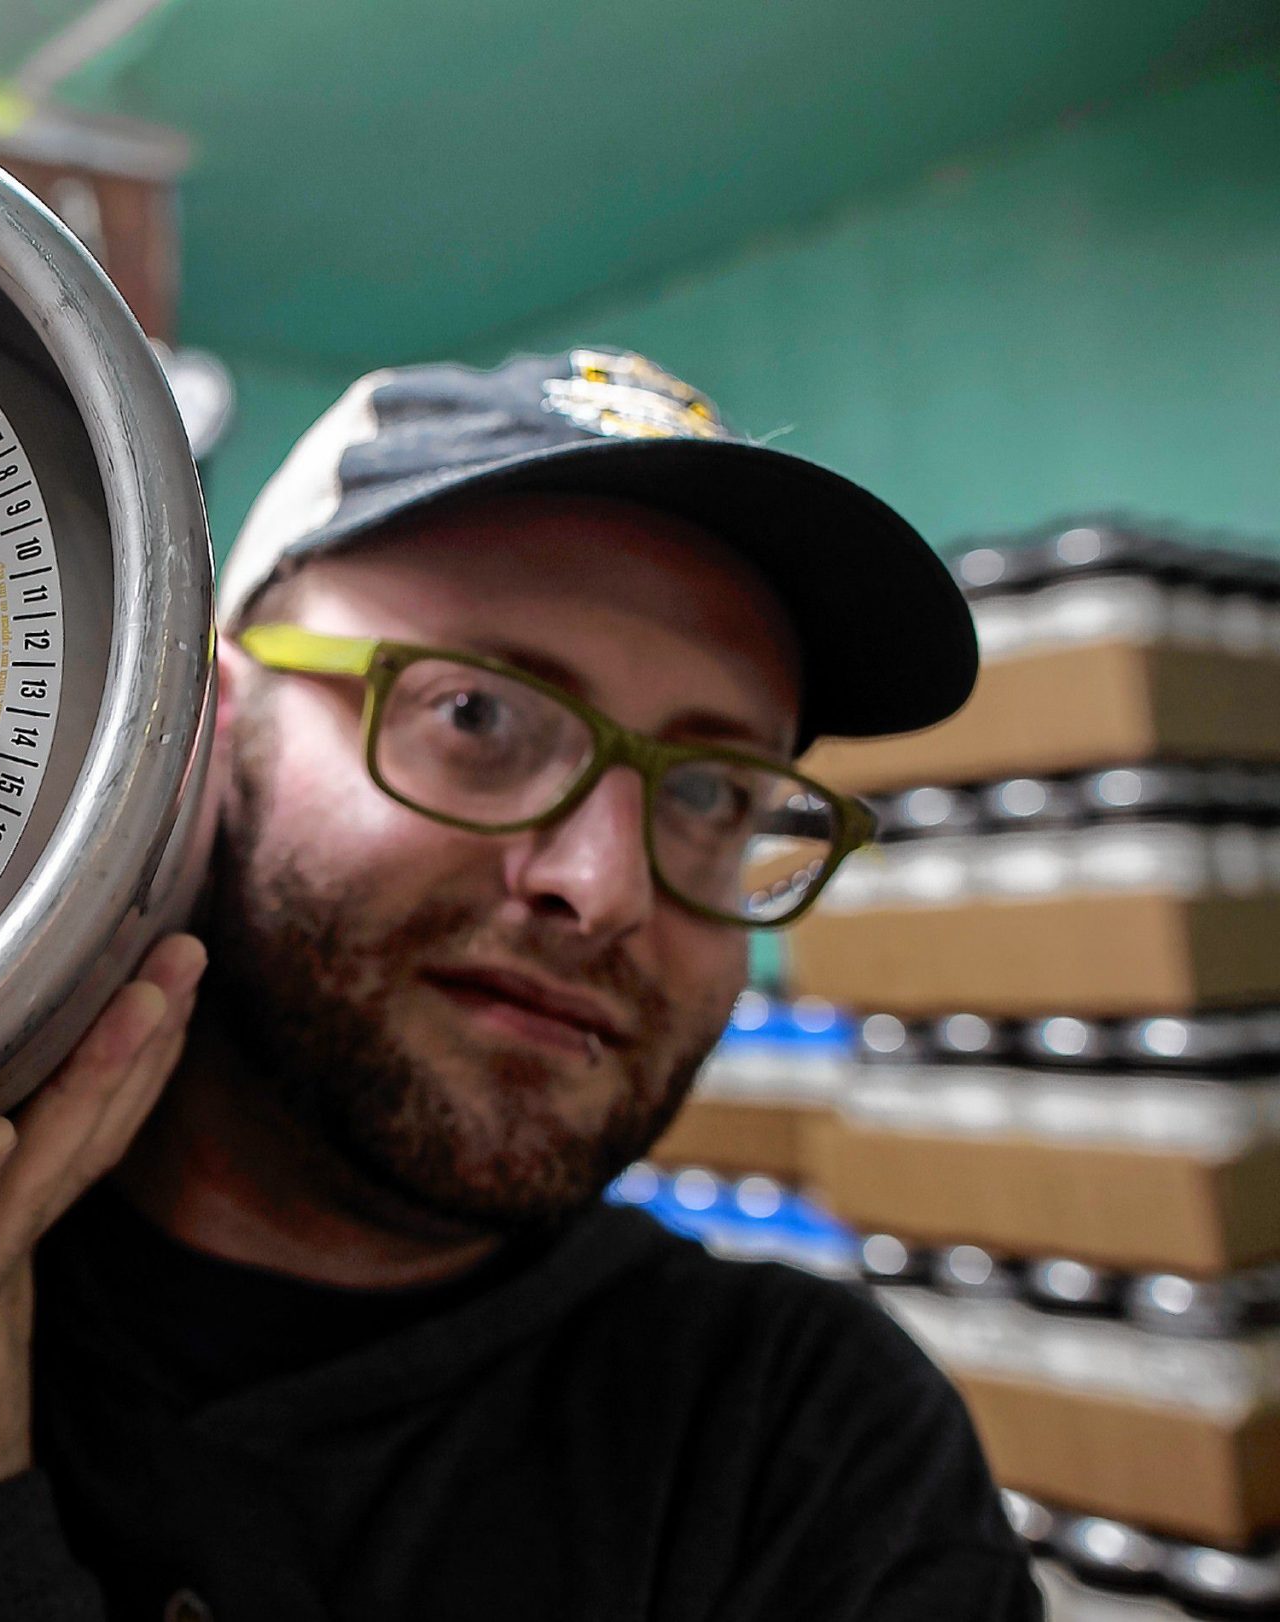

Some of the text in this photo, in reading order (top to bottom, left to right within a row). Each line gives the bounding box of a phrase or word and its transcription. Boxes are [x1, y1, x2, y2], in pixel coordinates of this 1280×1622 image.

[5, 499, 31, 516] 9
[14, 536, 42, 560] 10
[22, 584, 48, 603] 11
[0, 599, 8, 612] on
[0, 613, 12, 646] appear
[23, 629, 50, 650] 12
[0, 647, 12, 668] may
[20, 678, 47, 698] 13
[10, 726, 39, 748] 14
